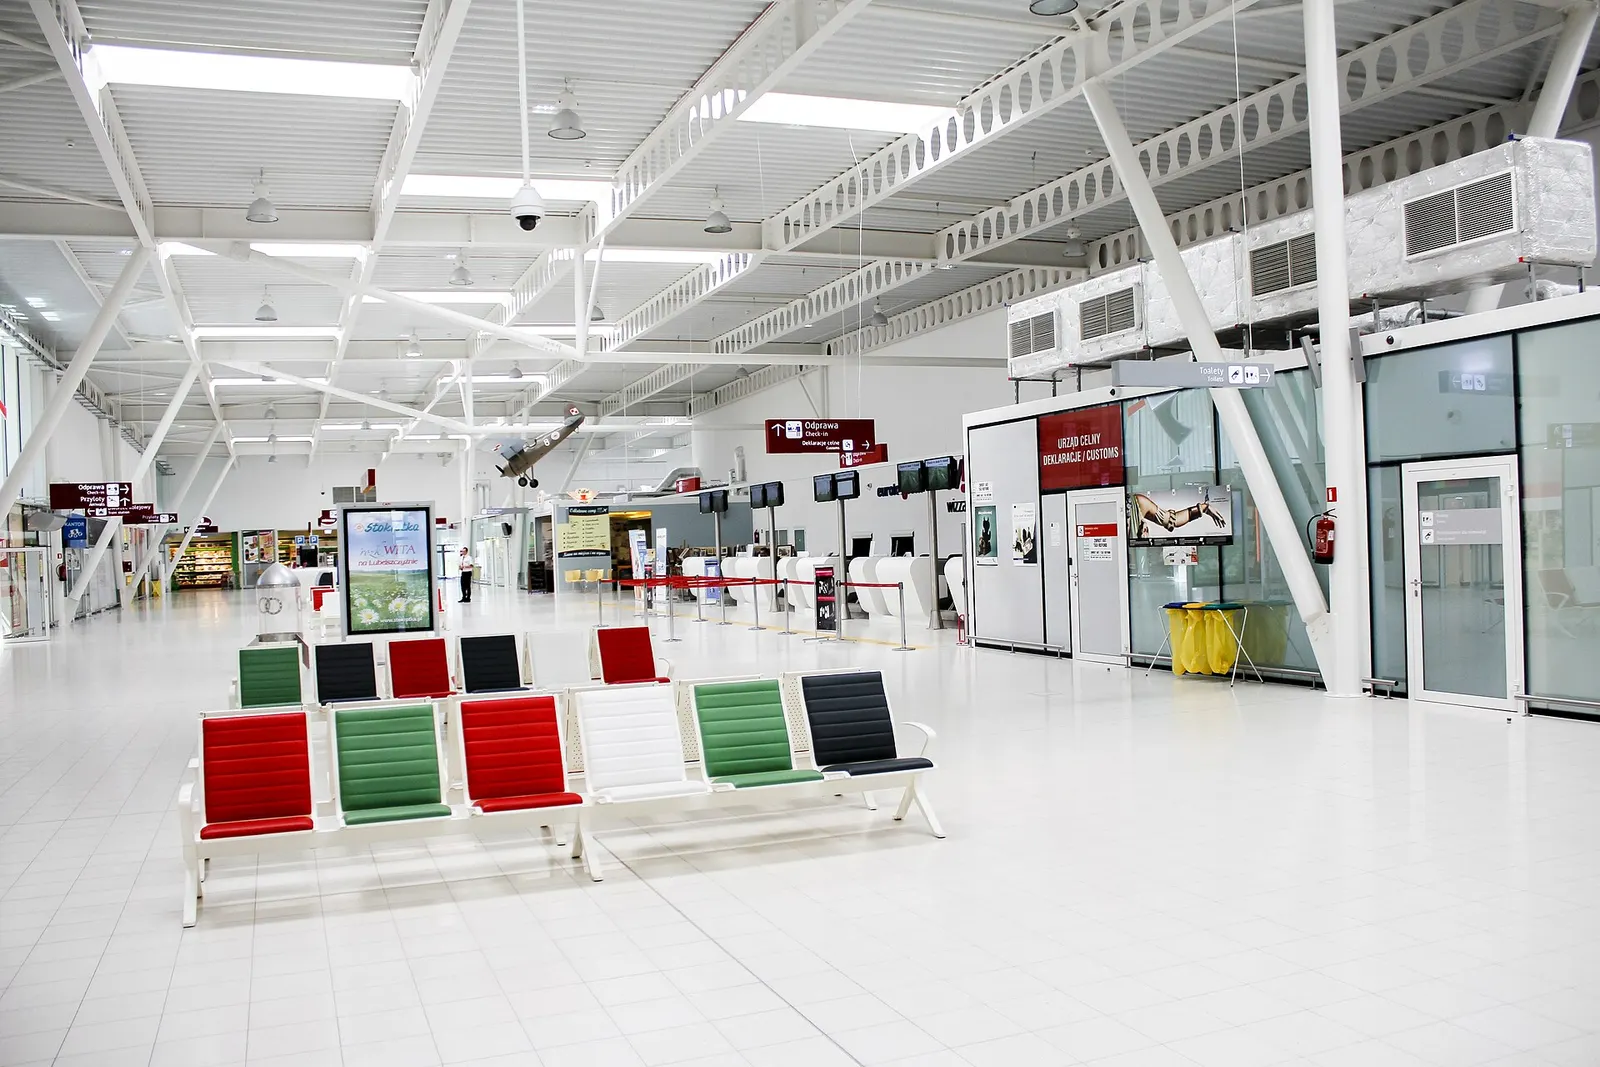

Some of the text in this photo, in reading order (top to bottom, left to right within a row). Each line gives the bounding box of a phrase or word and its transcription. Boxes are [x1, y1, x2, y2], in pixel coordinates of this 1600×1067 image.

[1199, 366, 1224, 376] Toalety
[1207, 375, 1224, 383] Toilets
[804, 421, 839, 431] Odprawa
[1057, 432, 1101, 450] URZĄD CELNY
[1043, 450, 1081, 466] DEKLARACJE
[1086, 446, 1119, 461] CUSTOMS
[80, 496, 106, 504] Przyloty
[364, 522, 420, 533] Stoktka
